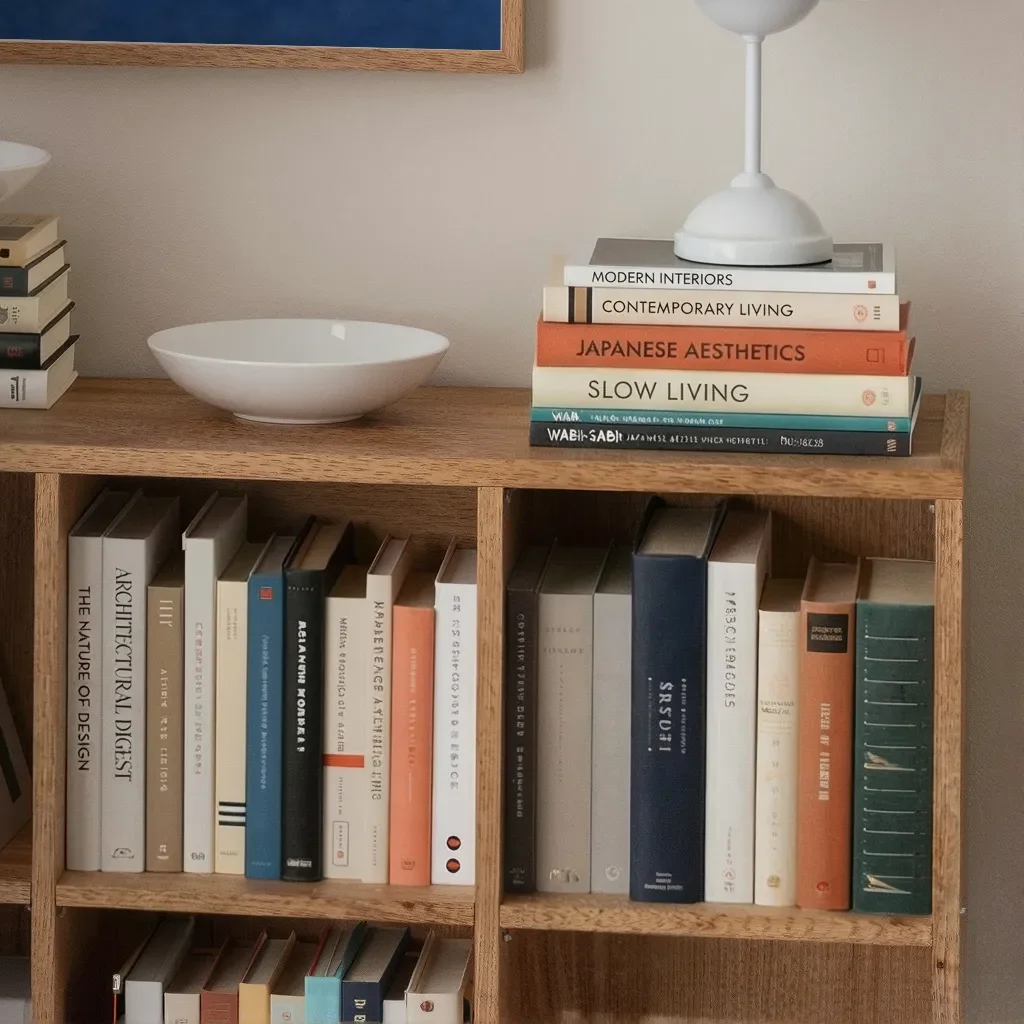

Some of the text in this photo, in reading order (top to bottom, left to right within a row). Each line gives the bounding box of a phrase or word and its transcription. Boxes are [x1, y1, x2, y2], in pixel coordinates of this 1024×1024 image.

[592, 272, 732, 285] MODERN INTERIORS
[602, 300, 793, 316] CONTEMPORARY LIVING
[576, 340, 805, 361] JAPANESE AESTHETICS
[589, 380, 748, 402] SLOW LIVING
[78, 585, 91, 770] THE NATURE OF DESIGN
[115, 568, 132, 781] ARCHITECTURAL DIGEST
